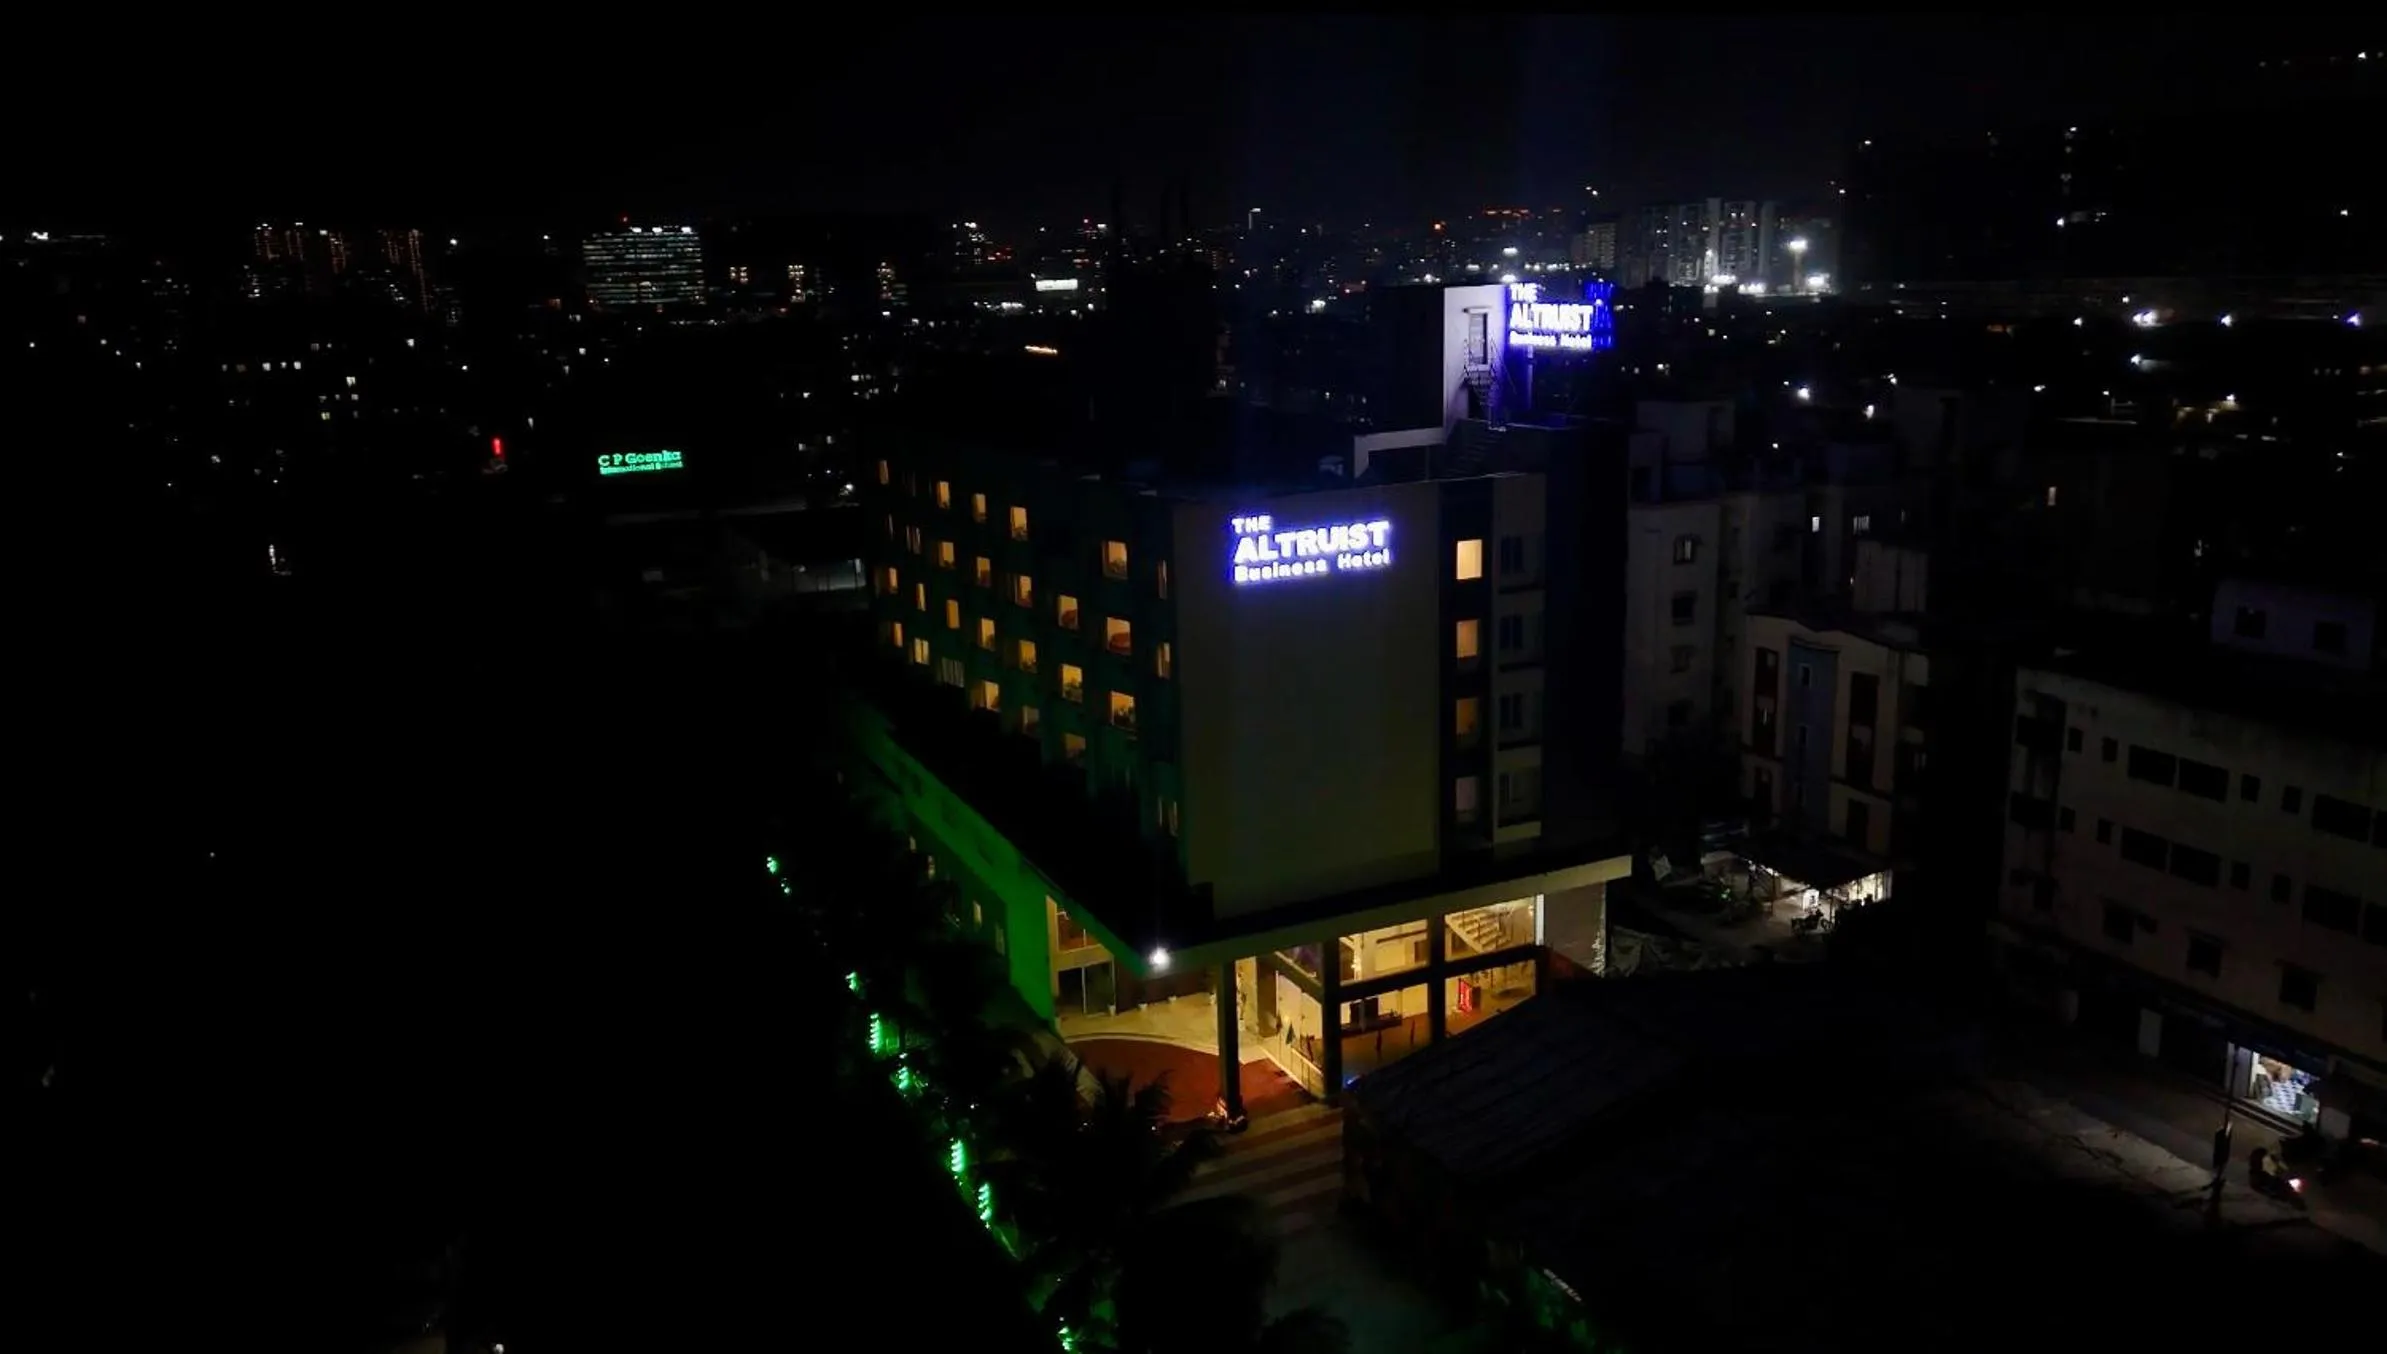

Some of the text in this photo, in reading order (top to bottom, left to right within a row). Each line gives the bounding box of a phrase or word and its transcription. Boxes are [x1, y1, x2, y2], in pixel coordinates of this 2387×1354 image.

[1510, 283, 1538, 302] THE
[1510, 303, 1594, 331] ALTRUIST
[598, 450, 682, 467] C P Goenka
[1231, 515, 1272, 534] THE
[1234, 520, 1390, 564] ALTRUIST
[1235, 548, 1391, 582] Business Hotel
